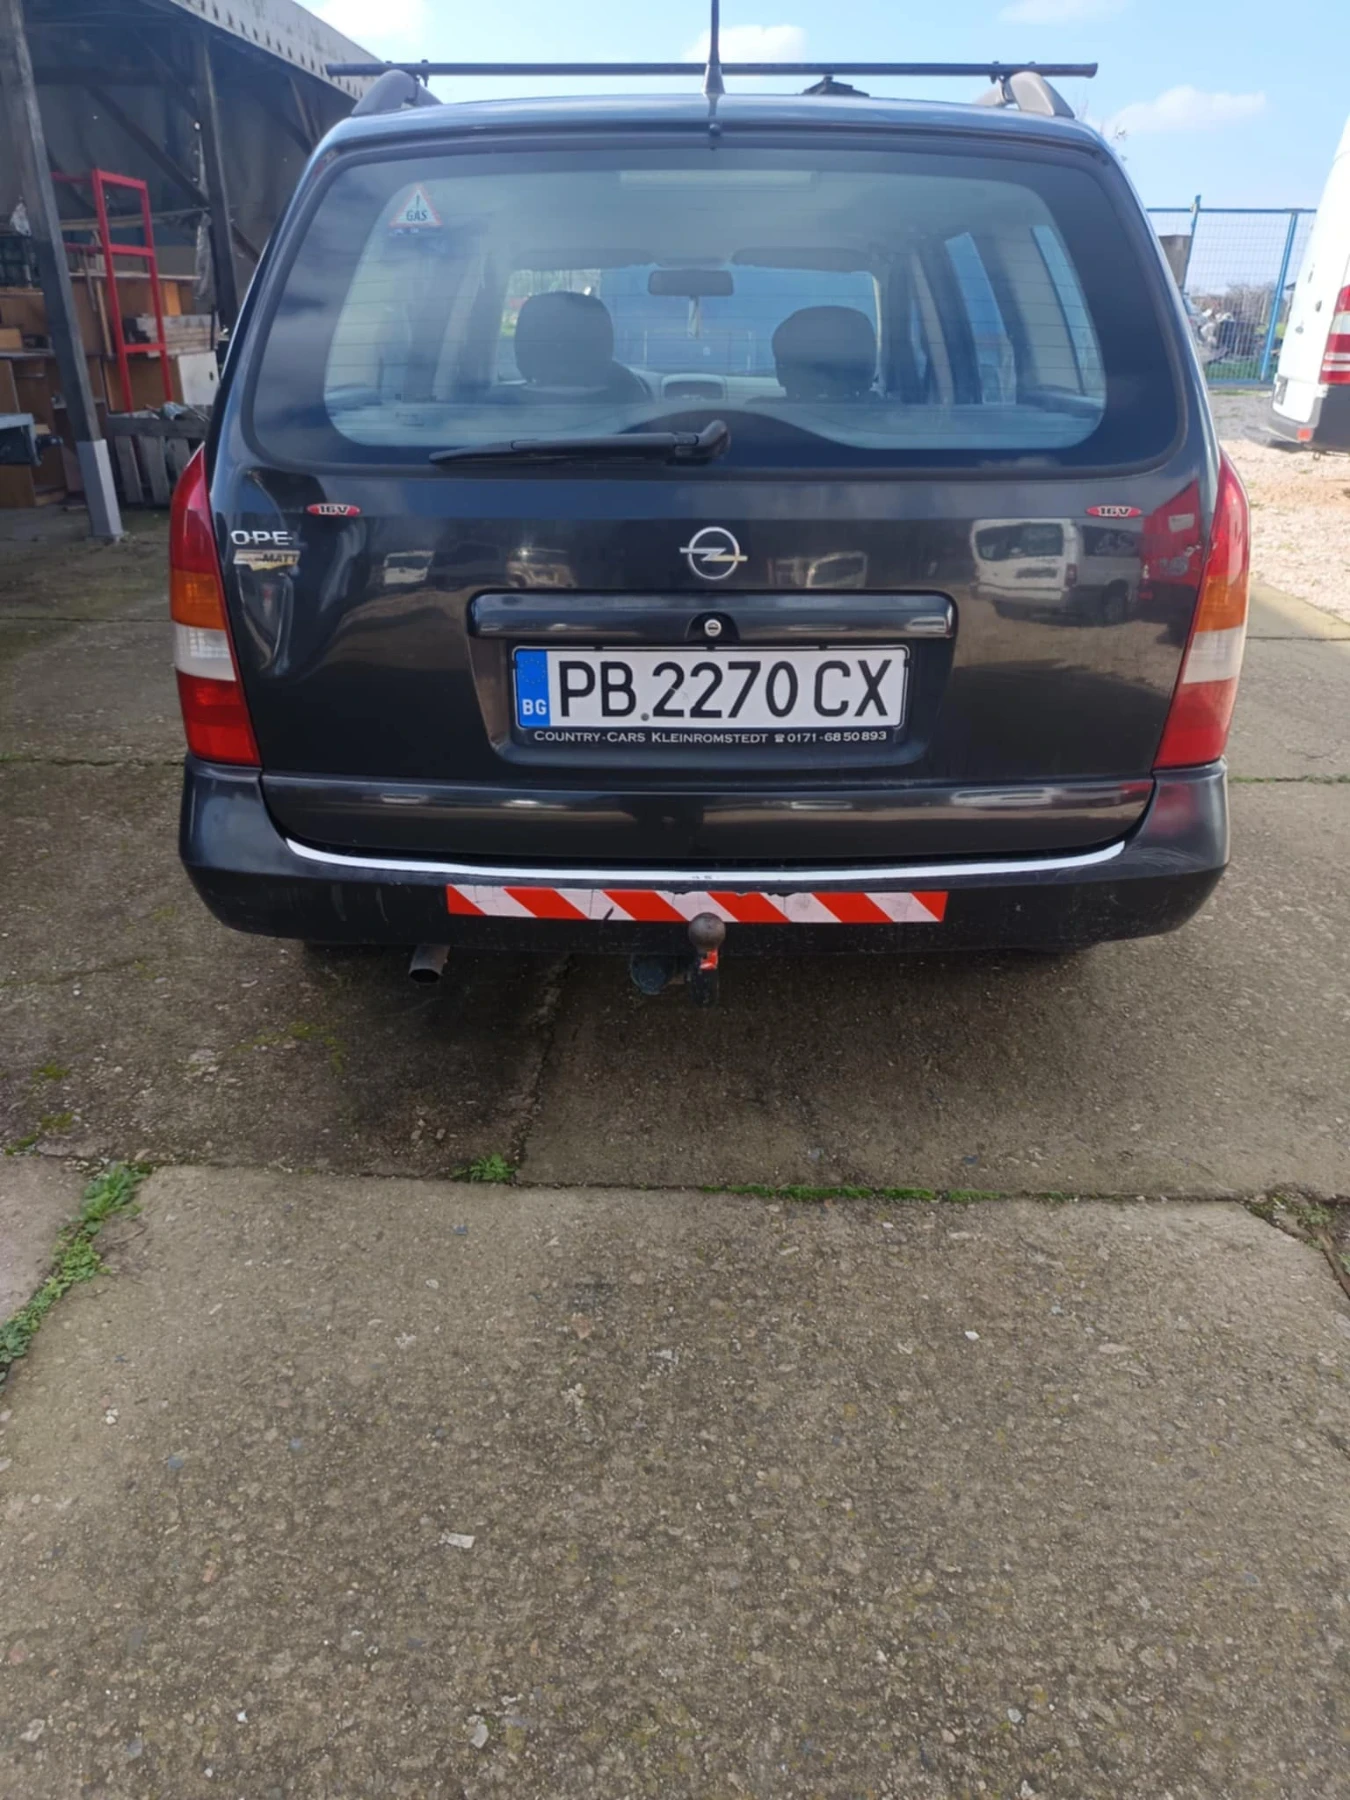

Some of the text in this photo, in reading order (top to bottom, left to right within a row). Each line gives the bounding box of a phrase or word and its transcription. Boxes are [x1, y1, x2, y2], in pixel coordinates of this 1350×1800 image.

[406, 210, 428, 221] GAS
[320, 505, 349, 515] 16V
[1100, 507, 1131, 516] 16V
[813, 659, 893, 718] CX
[522, 698, 548, 716] BG
[652, 731, 769, 744] KLEINROMSTEDT
